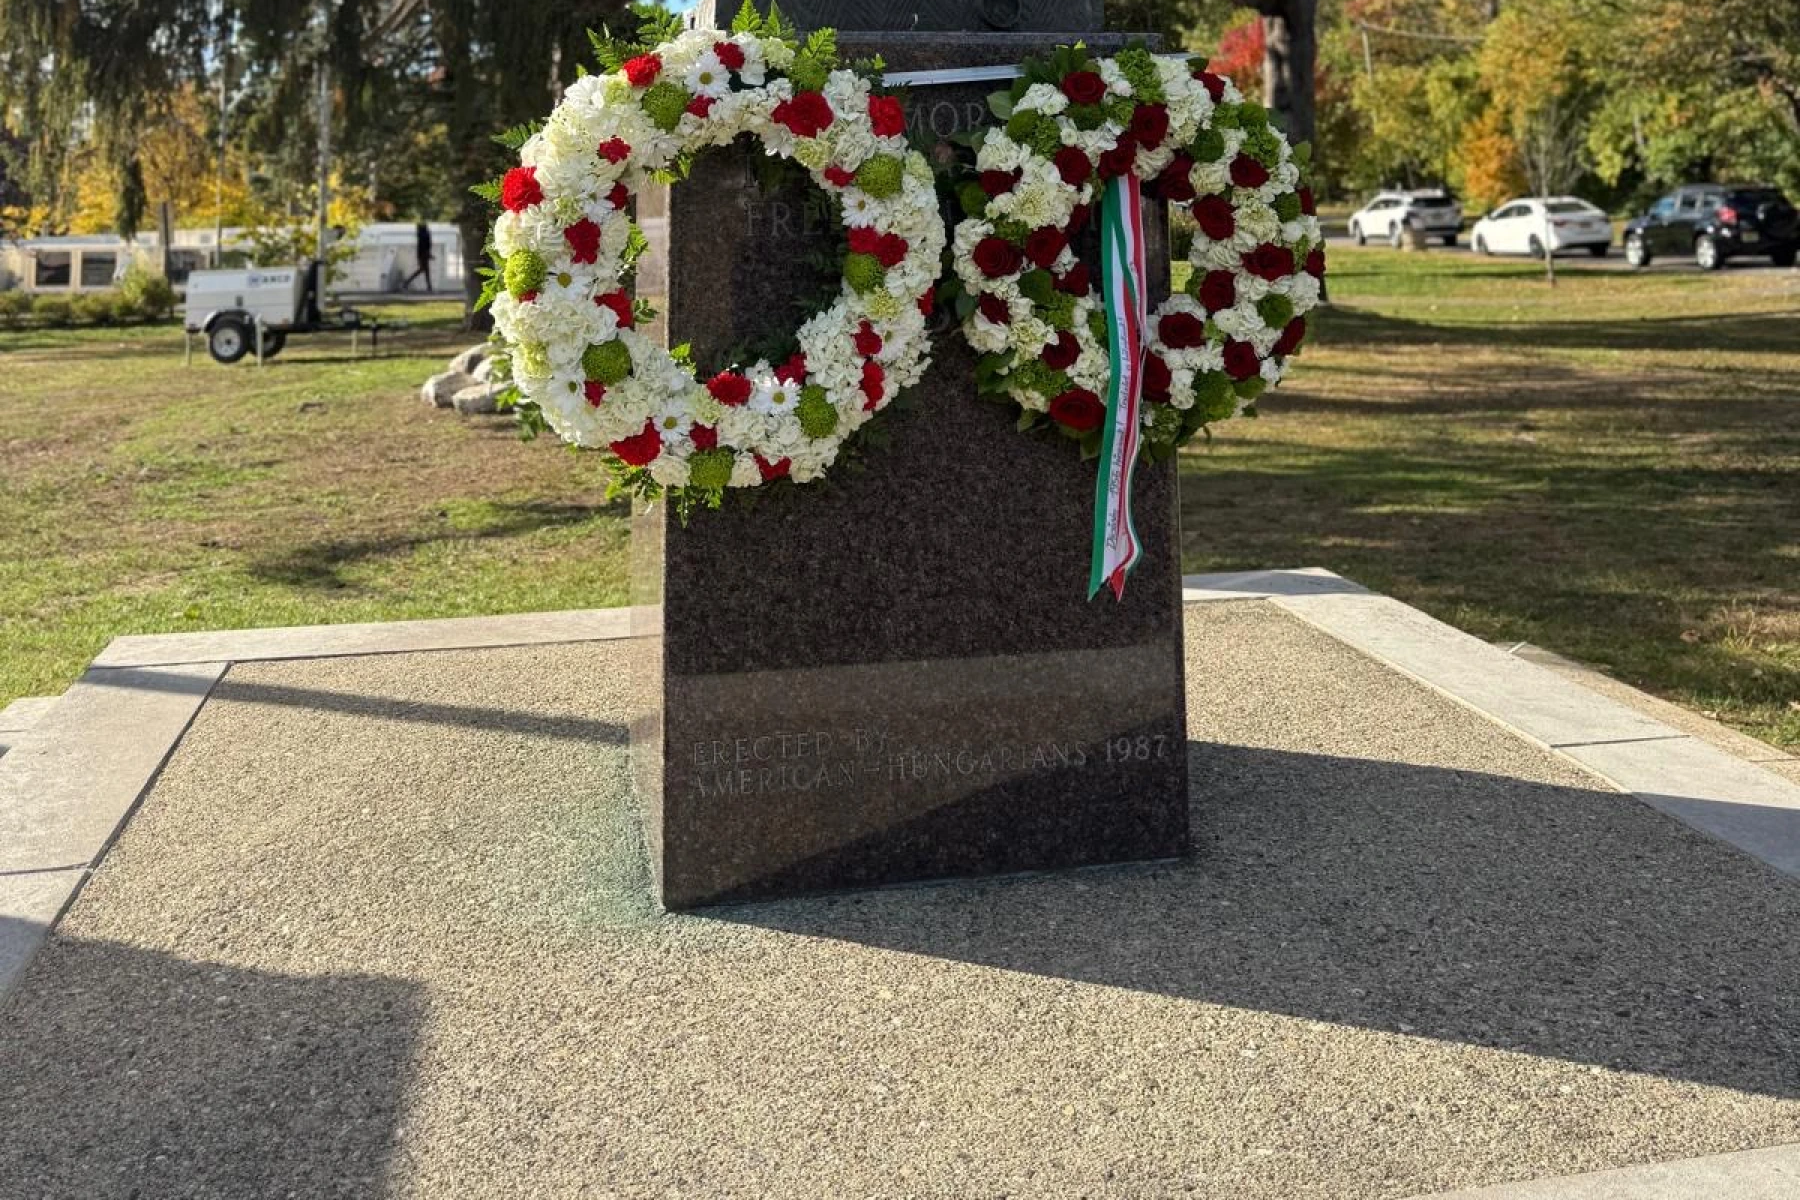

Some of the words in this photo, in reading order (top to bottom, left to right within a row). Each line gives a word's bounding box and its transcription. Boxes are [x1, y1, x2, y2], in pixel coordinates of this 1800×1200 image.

[693, 730, 833, 766] ERECTED
[855, 727, 889, 755] BY
[1105, 734, 1167, 763] 1987
